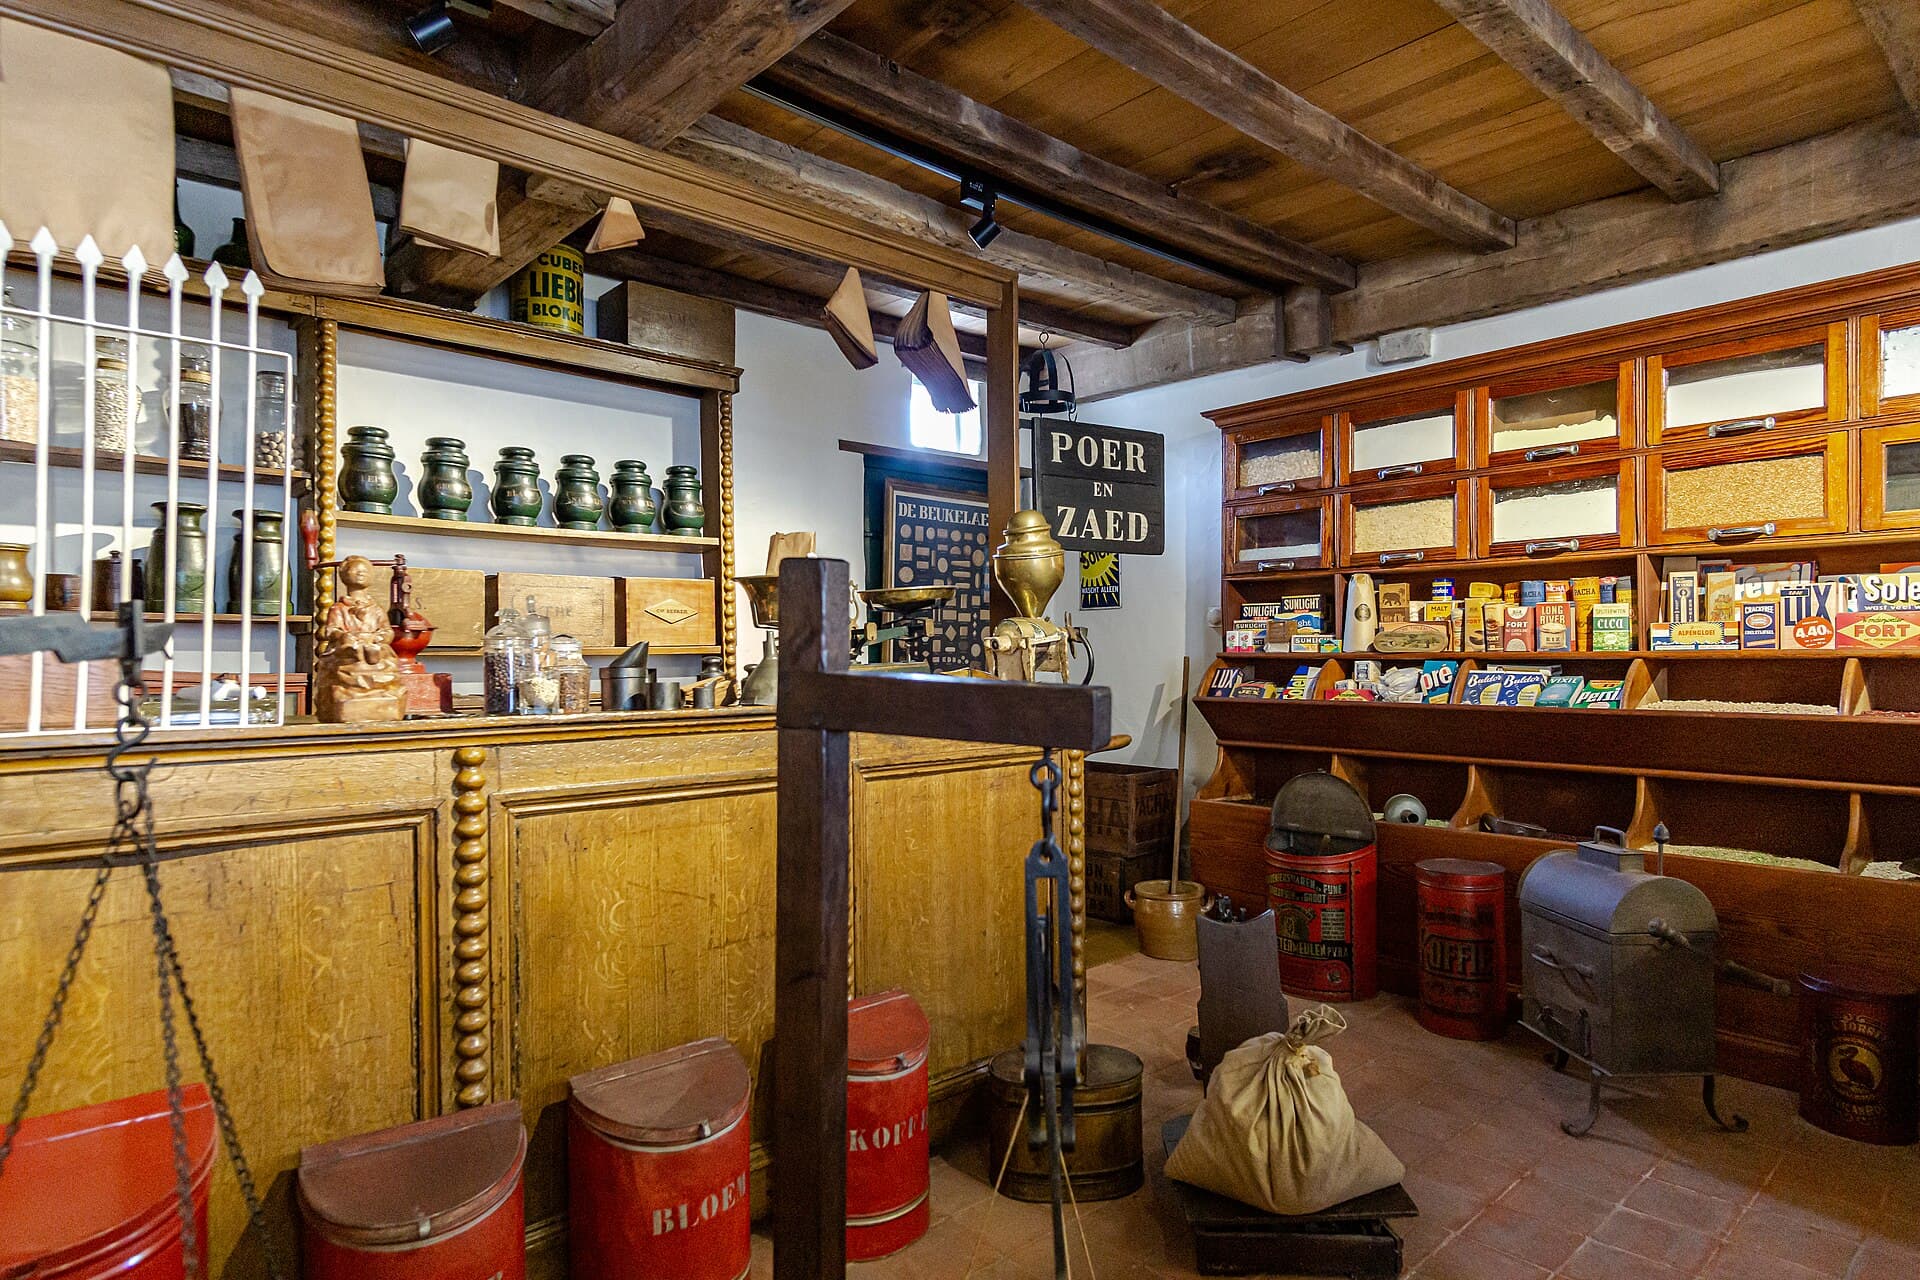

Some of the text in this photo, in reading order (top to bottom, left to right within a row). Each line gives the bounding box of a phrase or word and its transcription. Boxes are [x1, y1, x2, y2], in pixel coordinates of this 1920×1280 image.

[1051, 431, 1147, 473] POER
[1093, 481, 1114, 498] EN
[898, 502, 917, 518] DE
[1057, 505, 1149, 543] ZAED
[1283, 597, 1320, 610] SUNLIGHT
[1541, 605, 1564, 615] LONG
[1784, 585, 1833, 627] LUX
[1242, 606, 1280, 617] SUNLIGHT
[1540, 615, 1565, 625] RIVER
[1854, 623, 1911, 638] FORT
[1211, 669, 1239, 689] LUX
[1550, 676, 1578, 684] VIXIL
